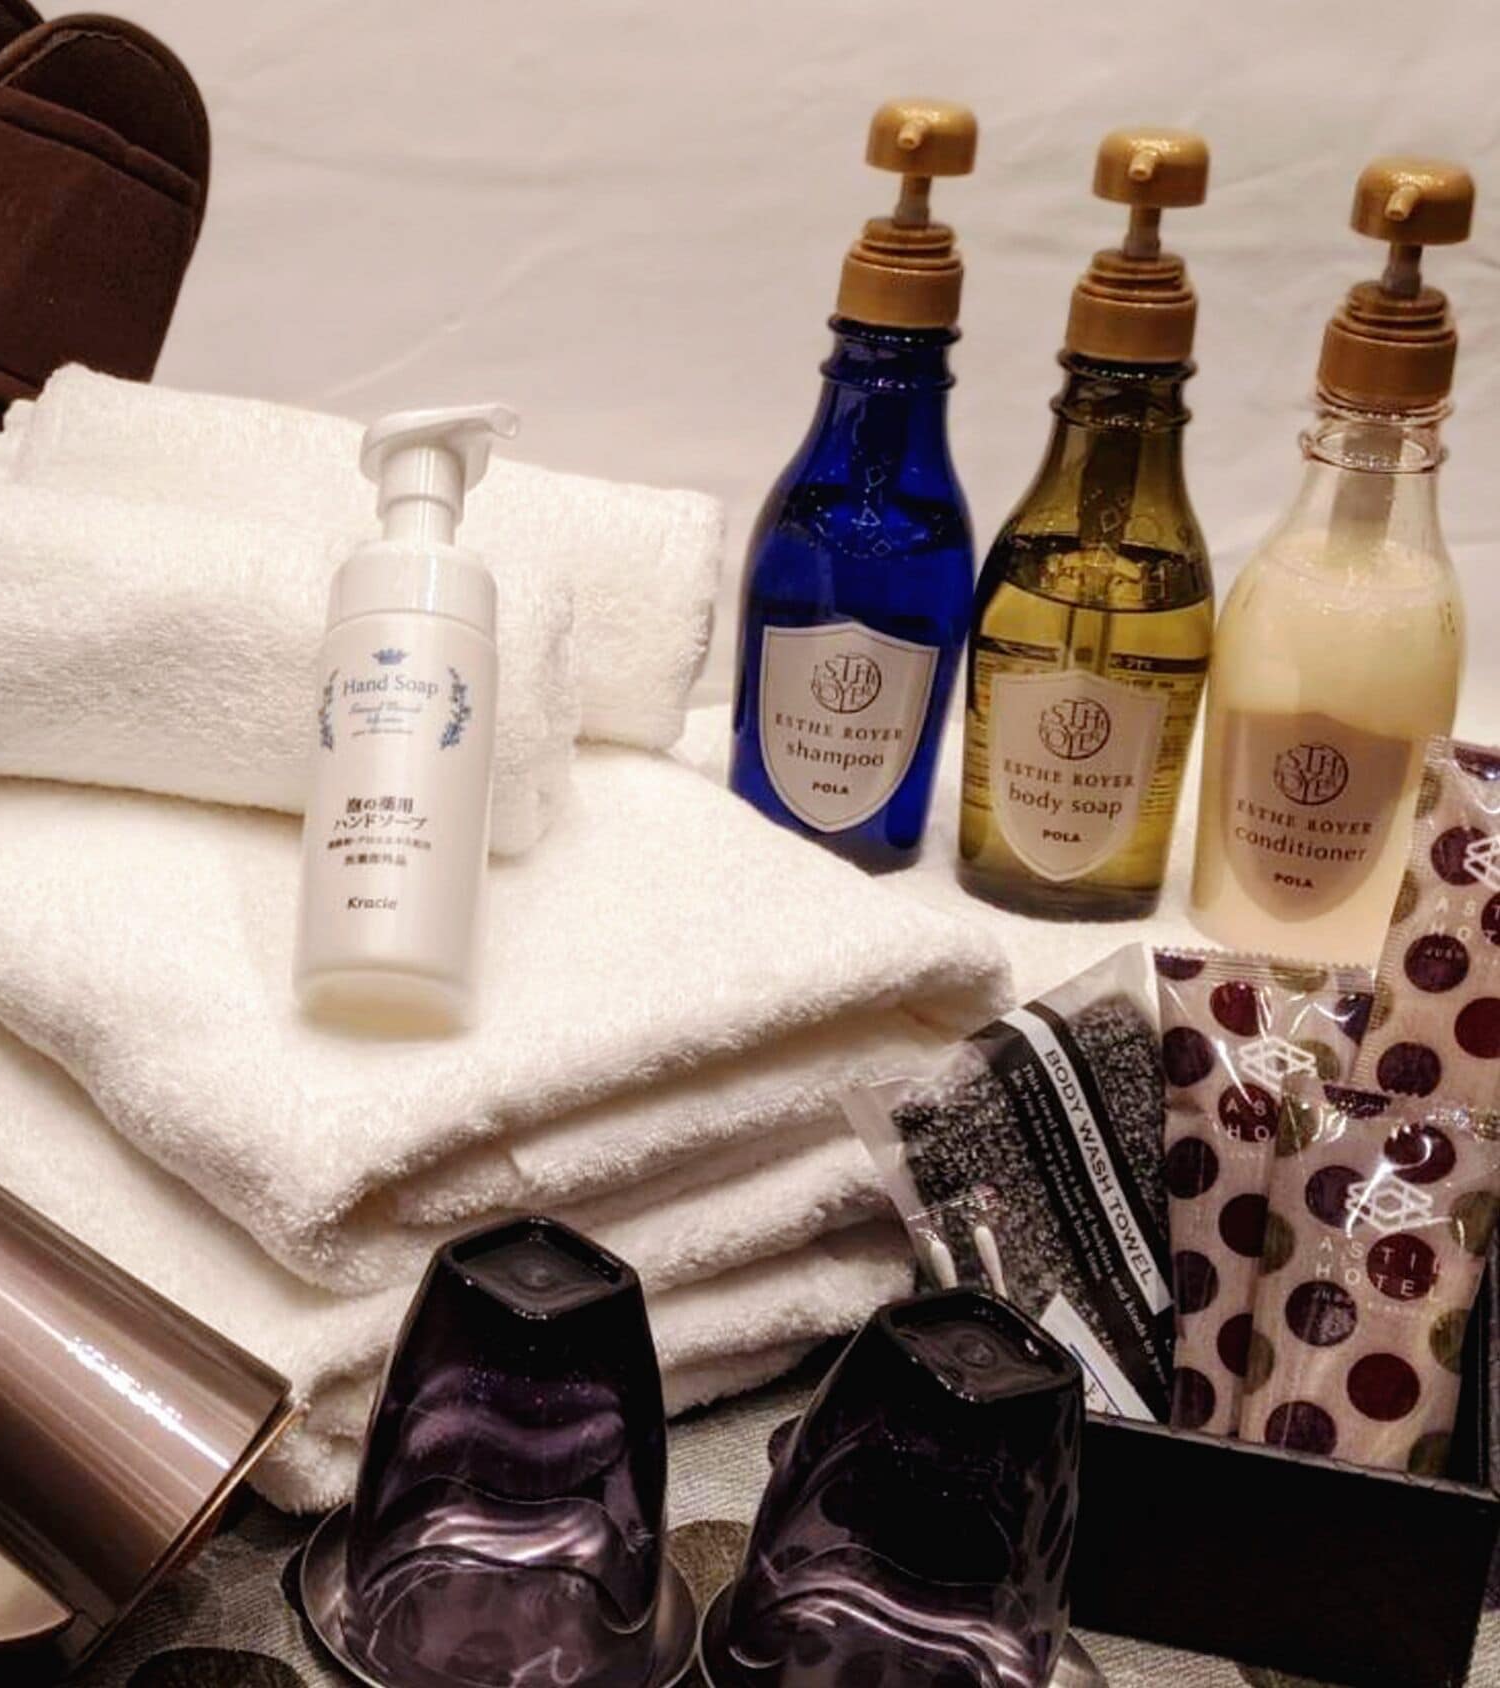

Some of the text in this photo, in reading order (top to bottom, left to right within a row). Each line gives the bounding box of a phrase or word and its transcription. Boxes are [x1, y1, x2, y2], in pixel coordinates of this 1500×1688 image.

[343, 674, 439, 698] Hand Soap
[775, 712, 904, 742] ESTHE ROYER
[786, 739, 884, 771] shampoo
[811, 781, 849, 795] POLA
[1003, 759, 1135, 788] ESTHE ROYER
[1008, 781, 1123, 820] body soap
[333, 813, 429, 831] ハンドソープ
[1236, 800, 1373, 835] ESTHE ROYER
[1043, 828, 1082, 843] POLA
[1235, 826, 1367, 862] conditioner
[1274, 872, 1314, 888] POLA
[347, 896, 398, 910] Kracie
[1045, 1047, 1151, 1287] BODY WASH TOWEL
[1022, 1063, 1040, 1092] This
[1082, 1207, 1097, 1222] of
[1111, 1276, 1130, 1301] and
[1124, 1301, 1148, 1338] kinds
[1315, 1262, 1438, 1301] HOTEL
